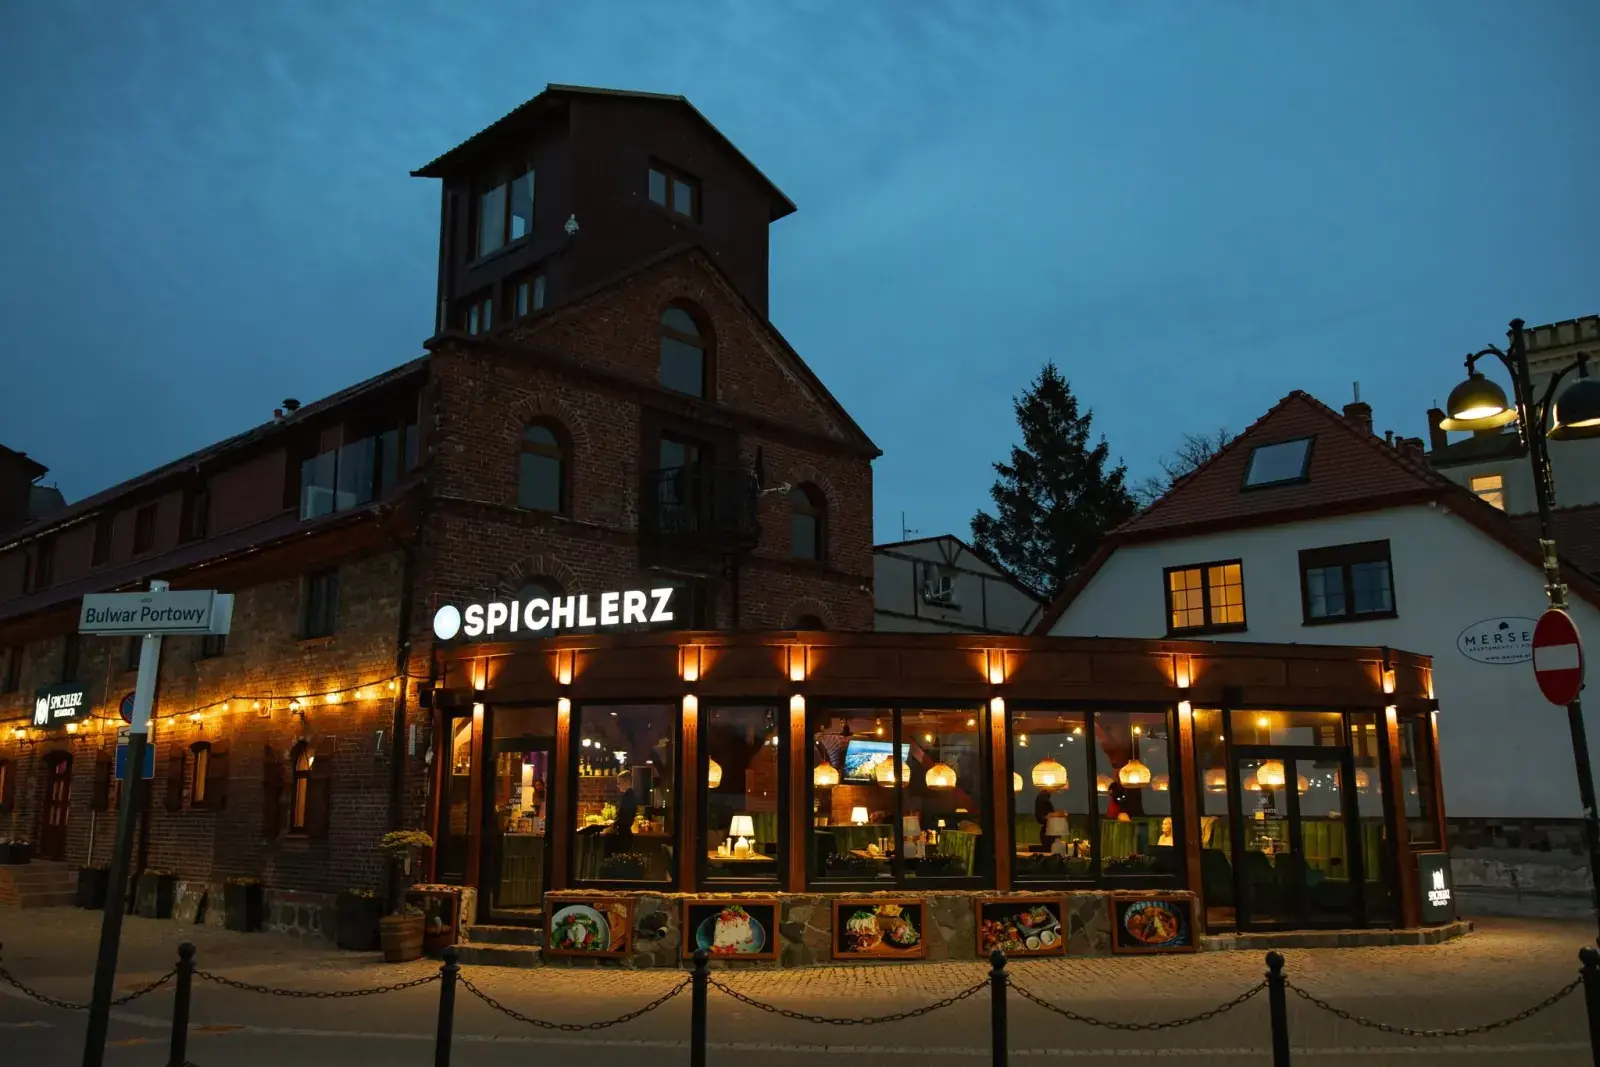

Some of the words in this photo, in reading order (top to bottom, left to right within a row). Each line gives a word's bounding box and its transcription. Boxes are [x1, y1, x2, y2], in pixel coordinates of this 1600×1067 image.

[85, 608, 137, 623] Bulwar
[140, 606, 205, 624] Portowy
[464, 588, 674, 637] SPICHLERZ
[1465, 631, 1531, 646] MERSE
[50, 692, 83, 710] SPICHLERZ
